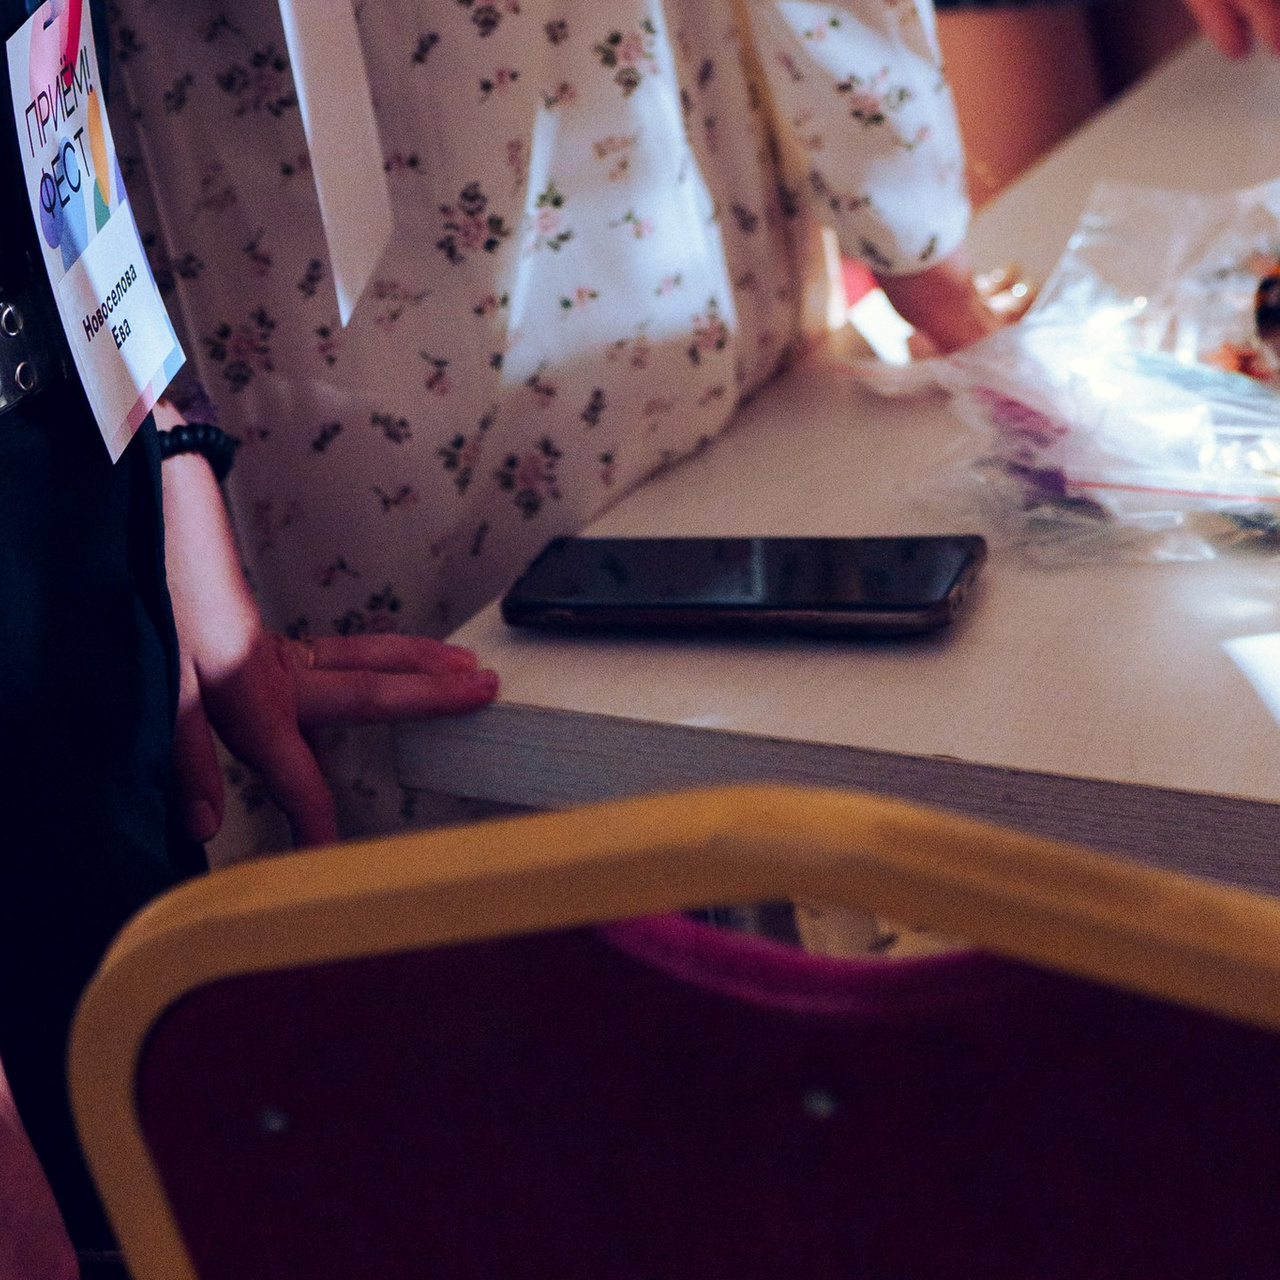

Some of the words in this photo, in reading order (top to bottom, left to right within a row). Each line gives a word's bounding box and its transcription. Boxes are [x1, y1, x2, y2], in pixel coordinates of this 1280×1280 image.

[24, 45, 93, 158] ПРИЁМ!
[40, 126, 90, 219] ФЕСТ
[82, 263, 137, 342] Новоселова
[111, 318, 131, 350] Ева
